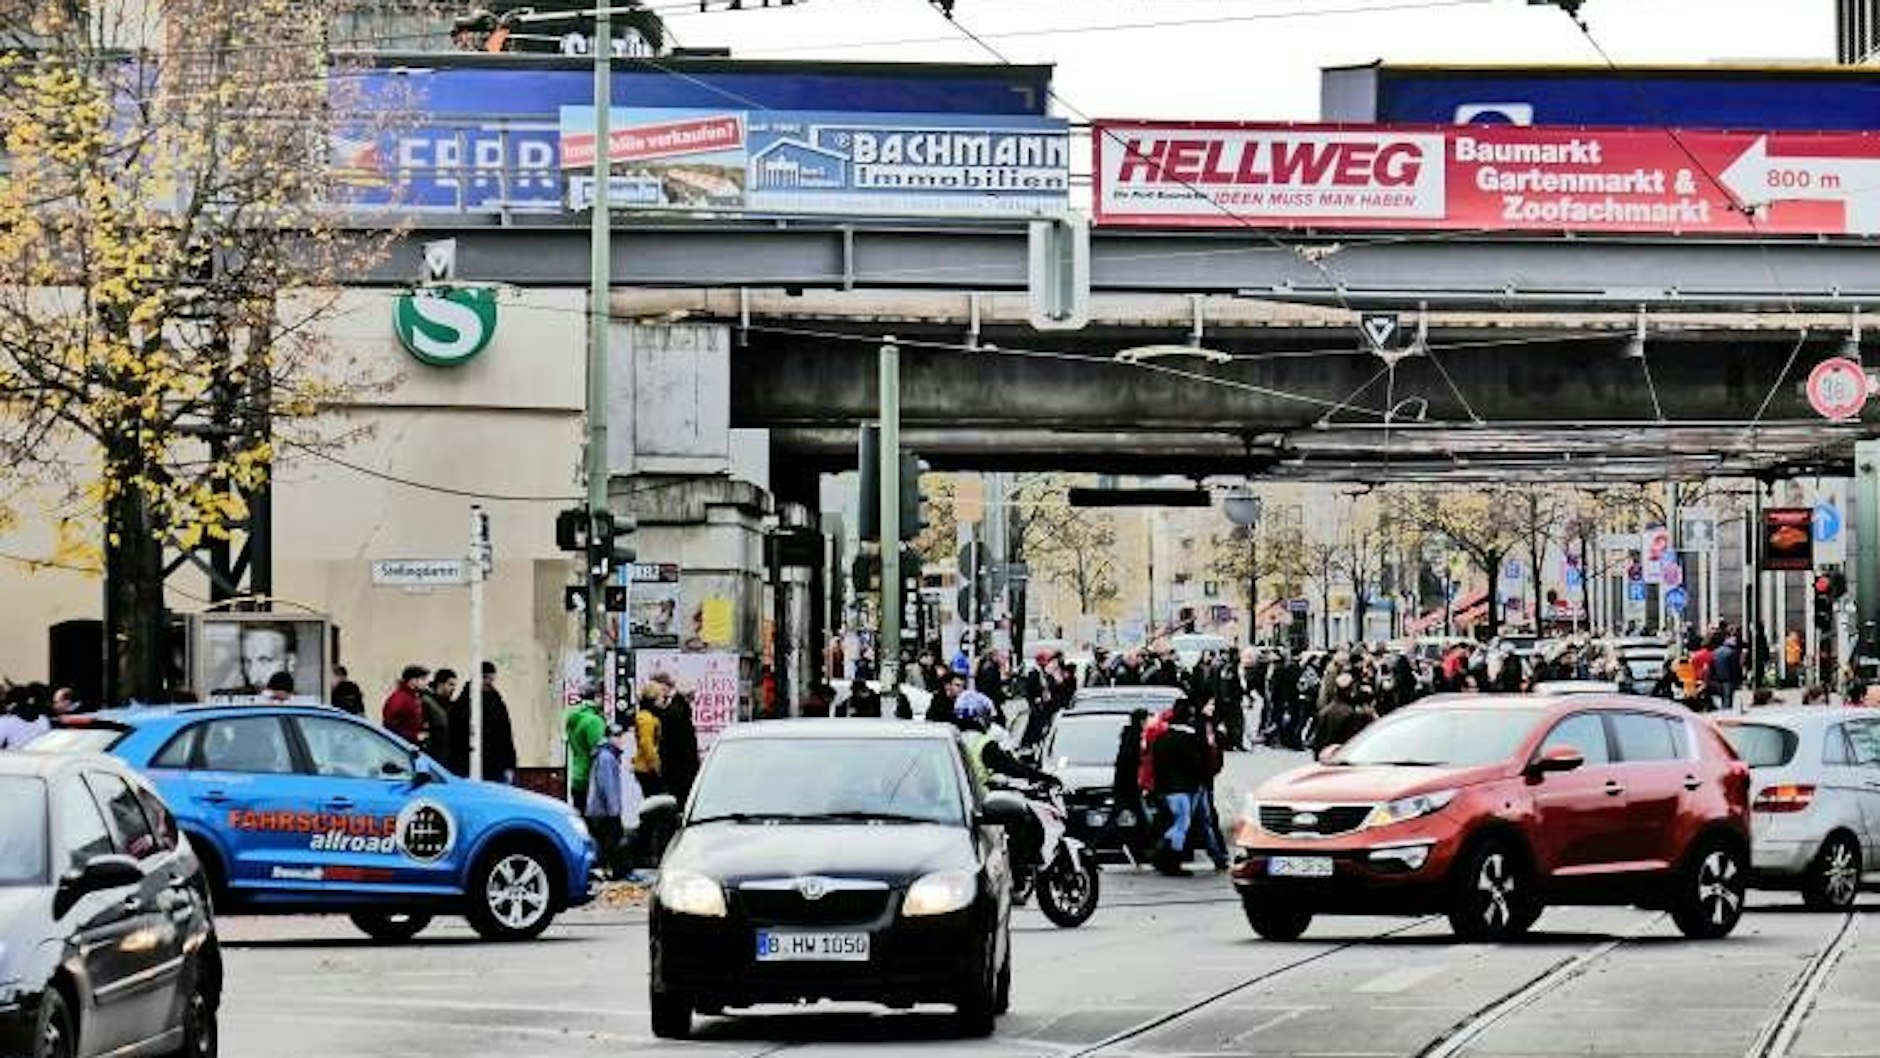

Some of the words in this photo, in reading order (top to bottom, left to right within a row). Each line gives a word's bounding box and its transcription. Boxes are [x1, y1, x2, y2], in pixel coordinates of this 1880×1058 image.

[565, 138, 645, 158] Immbilie
[647, 122, 734, 147] verkaufen?
[854, 131, 1067, 167] BACHMANN
[1456, 137, 1601, 163] Baumarkt
[1118, 140, 1424, 187] HELLWEG
[859, 166, 1063, 189] Immobilien
[1477, 168, 1665, 194] Gartenmarkt
[1674, 169, 1697, 194] &
[1767, 170, 1811, 189] 800
[1820, 174, 1841, 188] m
[1214, 193, 1263, 206] IDEEN
[1268, 194, 1314, 207] MUSS
[1319, 194, 1356, 207] MAN
[1360, 194, 1417, 208] HABEN
[1503, 195, 1711, 223] Zoofachmarkt
[412, 288, 483, 359] S
[694, 693, 736, 705] VERY
[693, 708, 736, 721] IGHT
[229, 809, 399, 836] FAHRSCHULE
[310, 831, 399, 853] allroad
